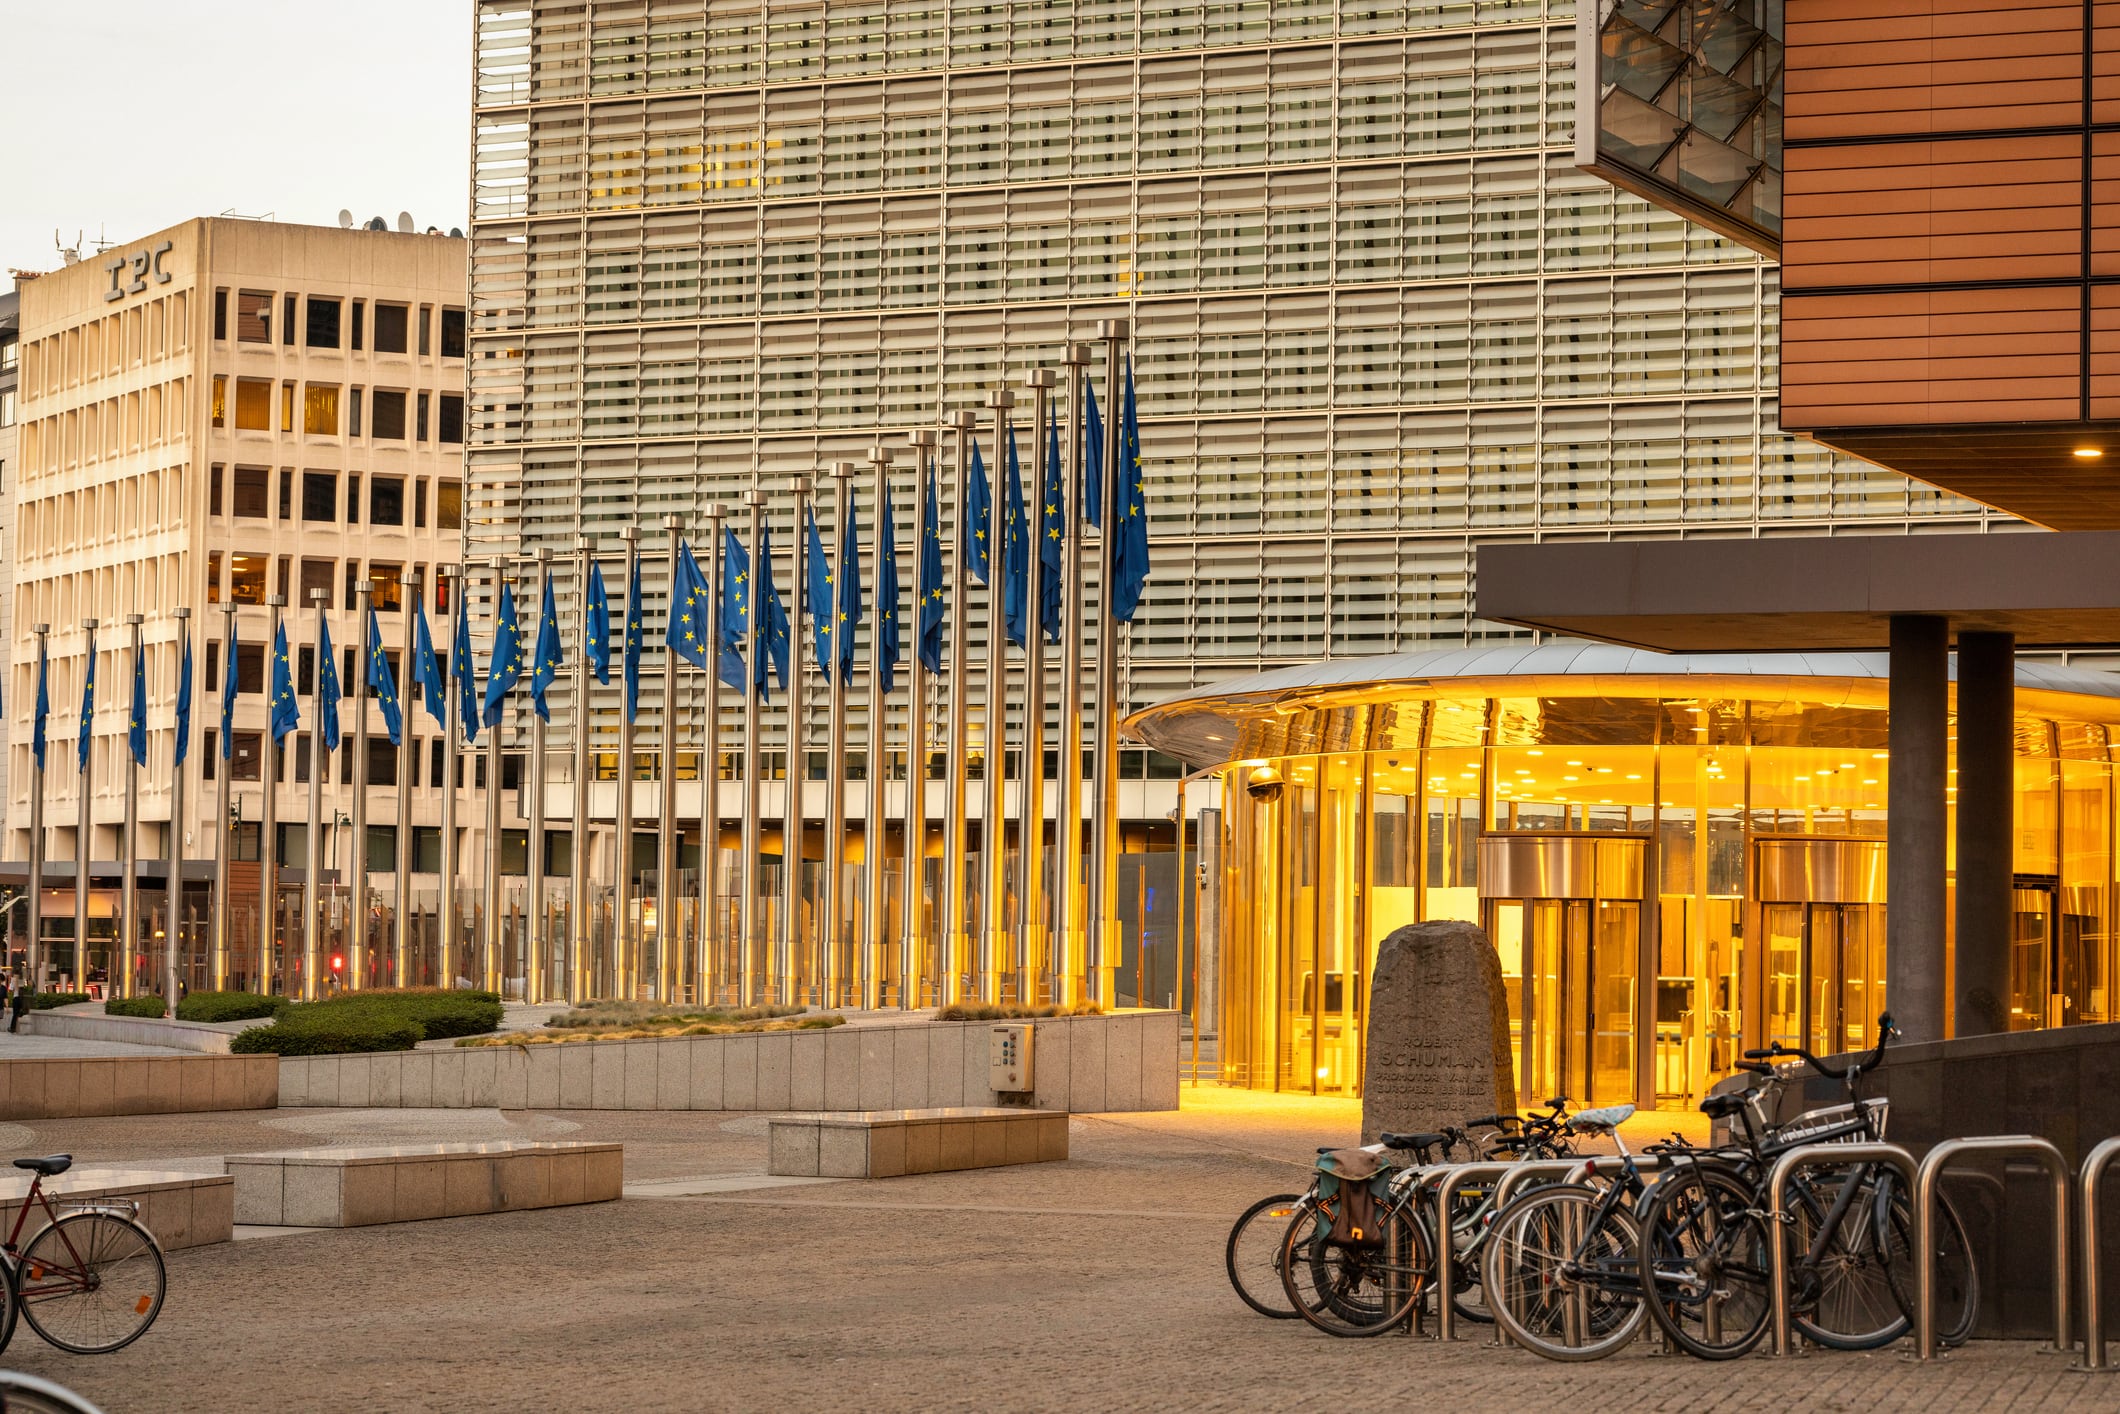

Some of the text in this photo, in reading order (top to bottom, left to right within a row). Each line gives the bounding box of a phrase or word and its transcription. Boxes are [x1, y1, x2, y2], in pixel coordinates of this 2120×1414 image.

[104, 240, 173, 302] IPC
[1402, 1036, 1463, 1049] ROBERT
[1380, 1053, 1486, 1069] SCHUMAN
[1374, 1071, 1489, 1083] PROMOTOR VAN DE
[1376, 1084, 1434, 1095] EUROPESE
